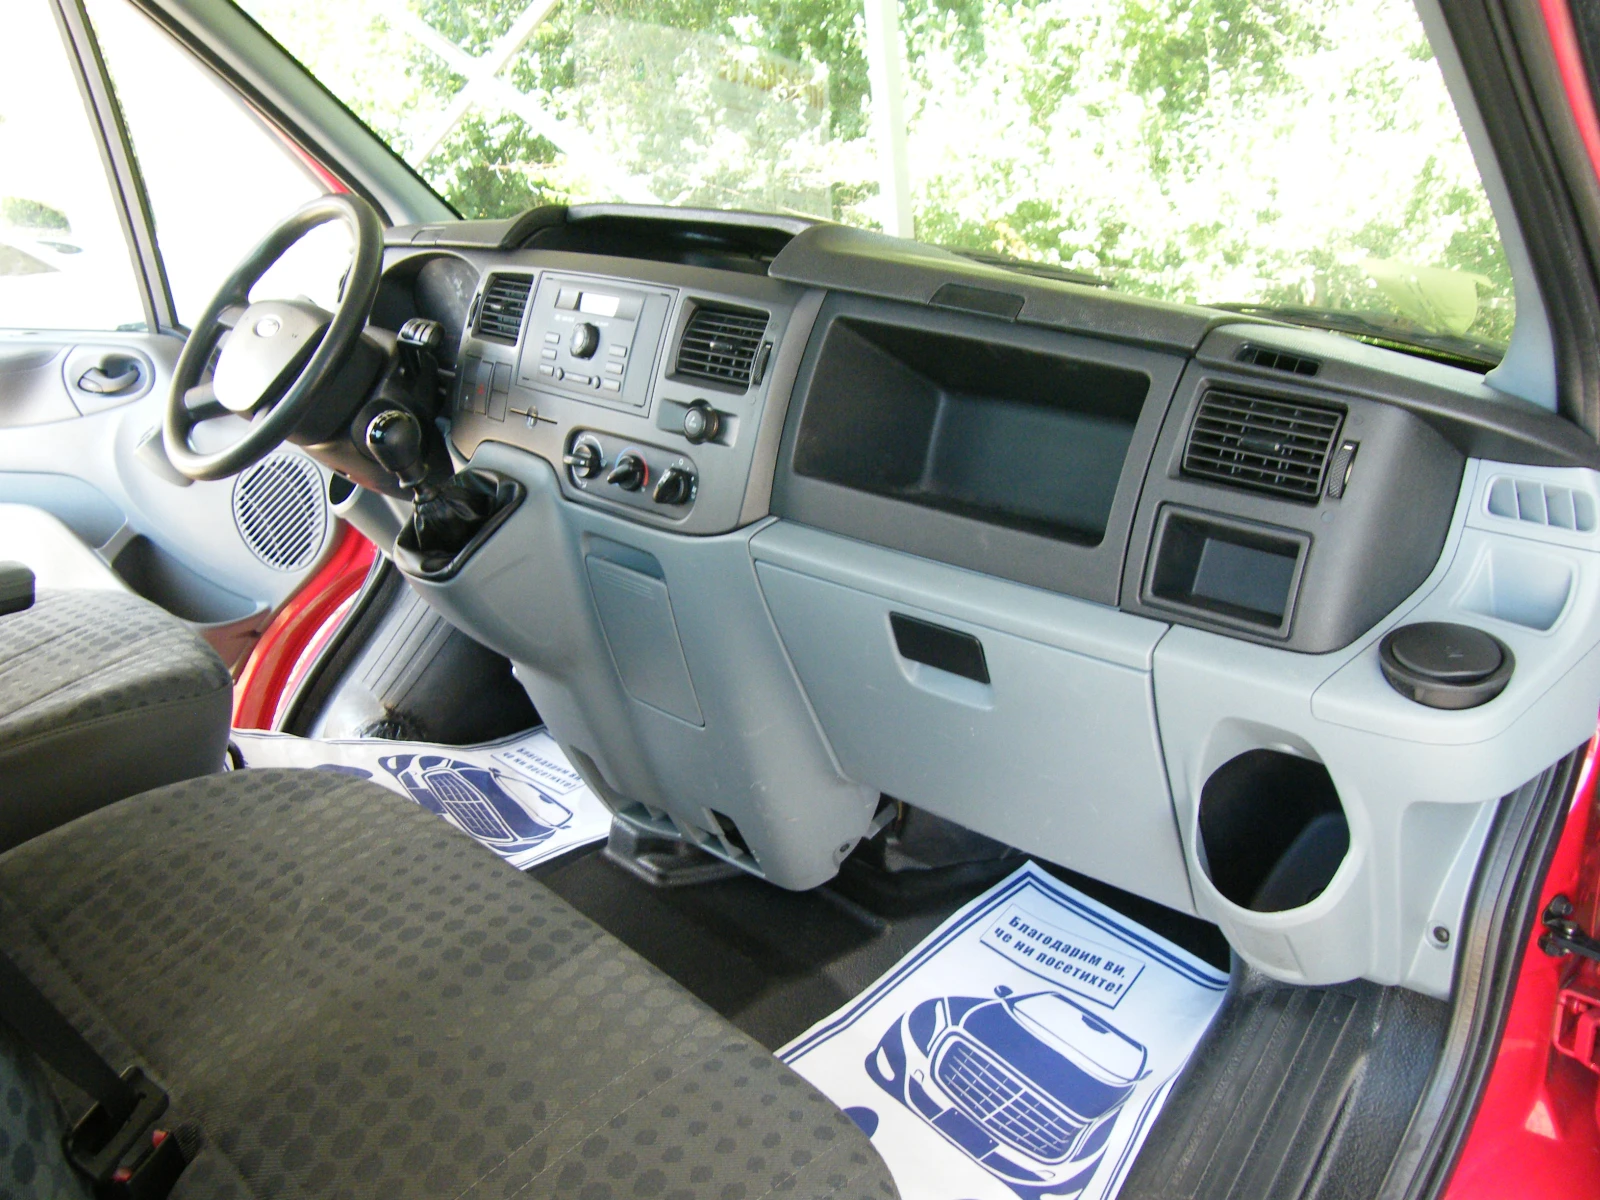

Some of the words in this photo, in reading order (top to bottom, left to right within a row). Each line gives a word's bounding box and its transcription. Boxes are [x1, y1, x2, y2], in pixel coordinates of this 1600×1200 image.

[994, 927, 1013, 943] че
[1014, 940, 1035, 957] ни
[1036, 952, 1124, 995] посетихте!
[1008, 916, 1102, 967] Благодарим
[1103, 961, 1126, 979] ви,
